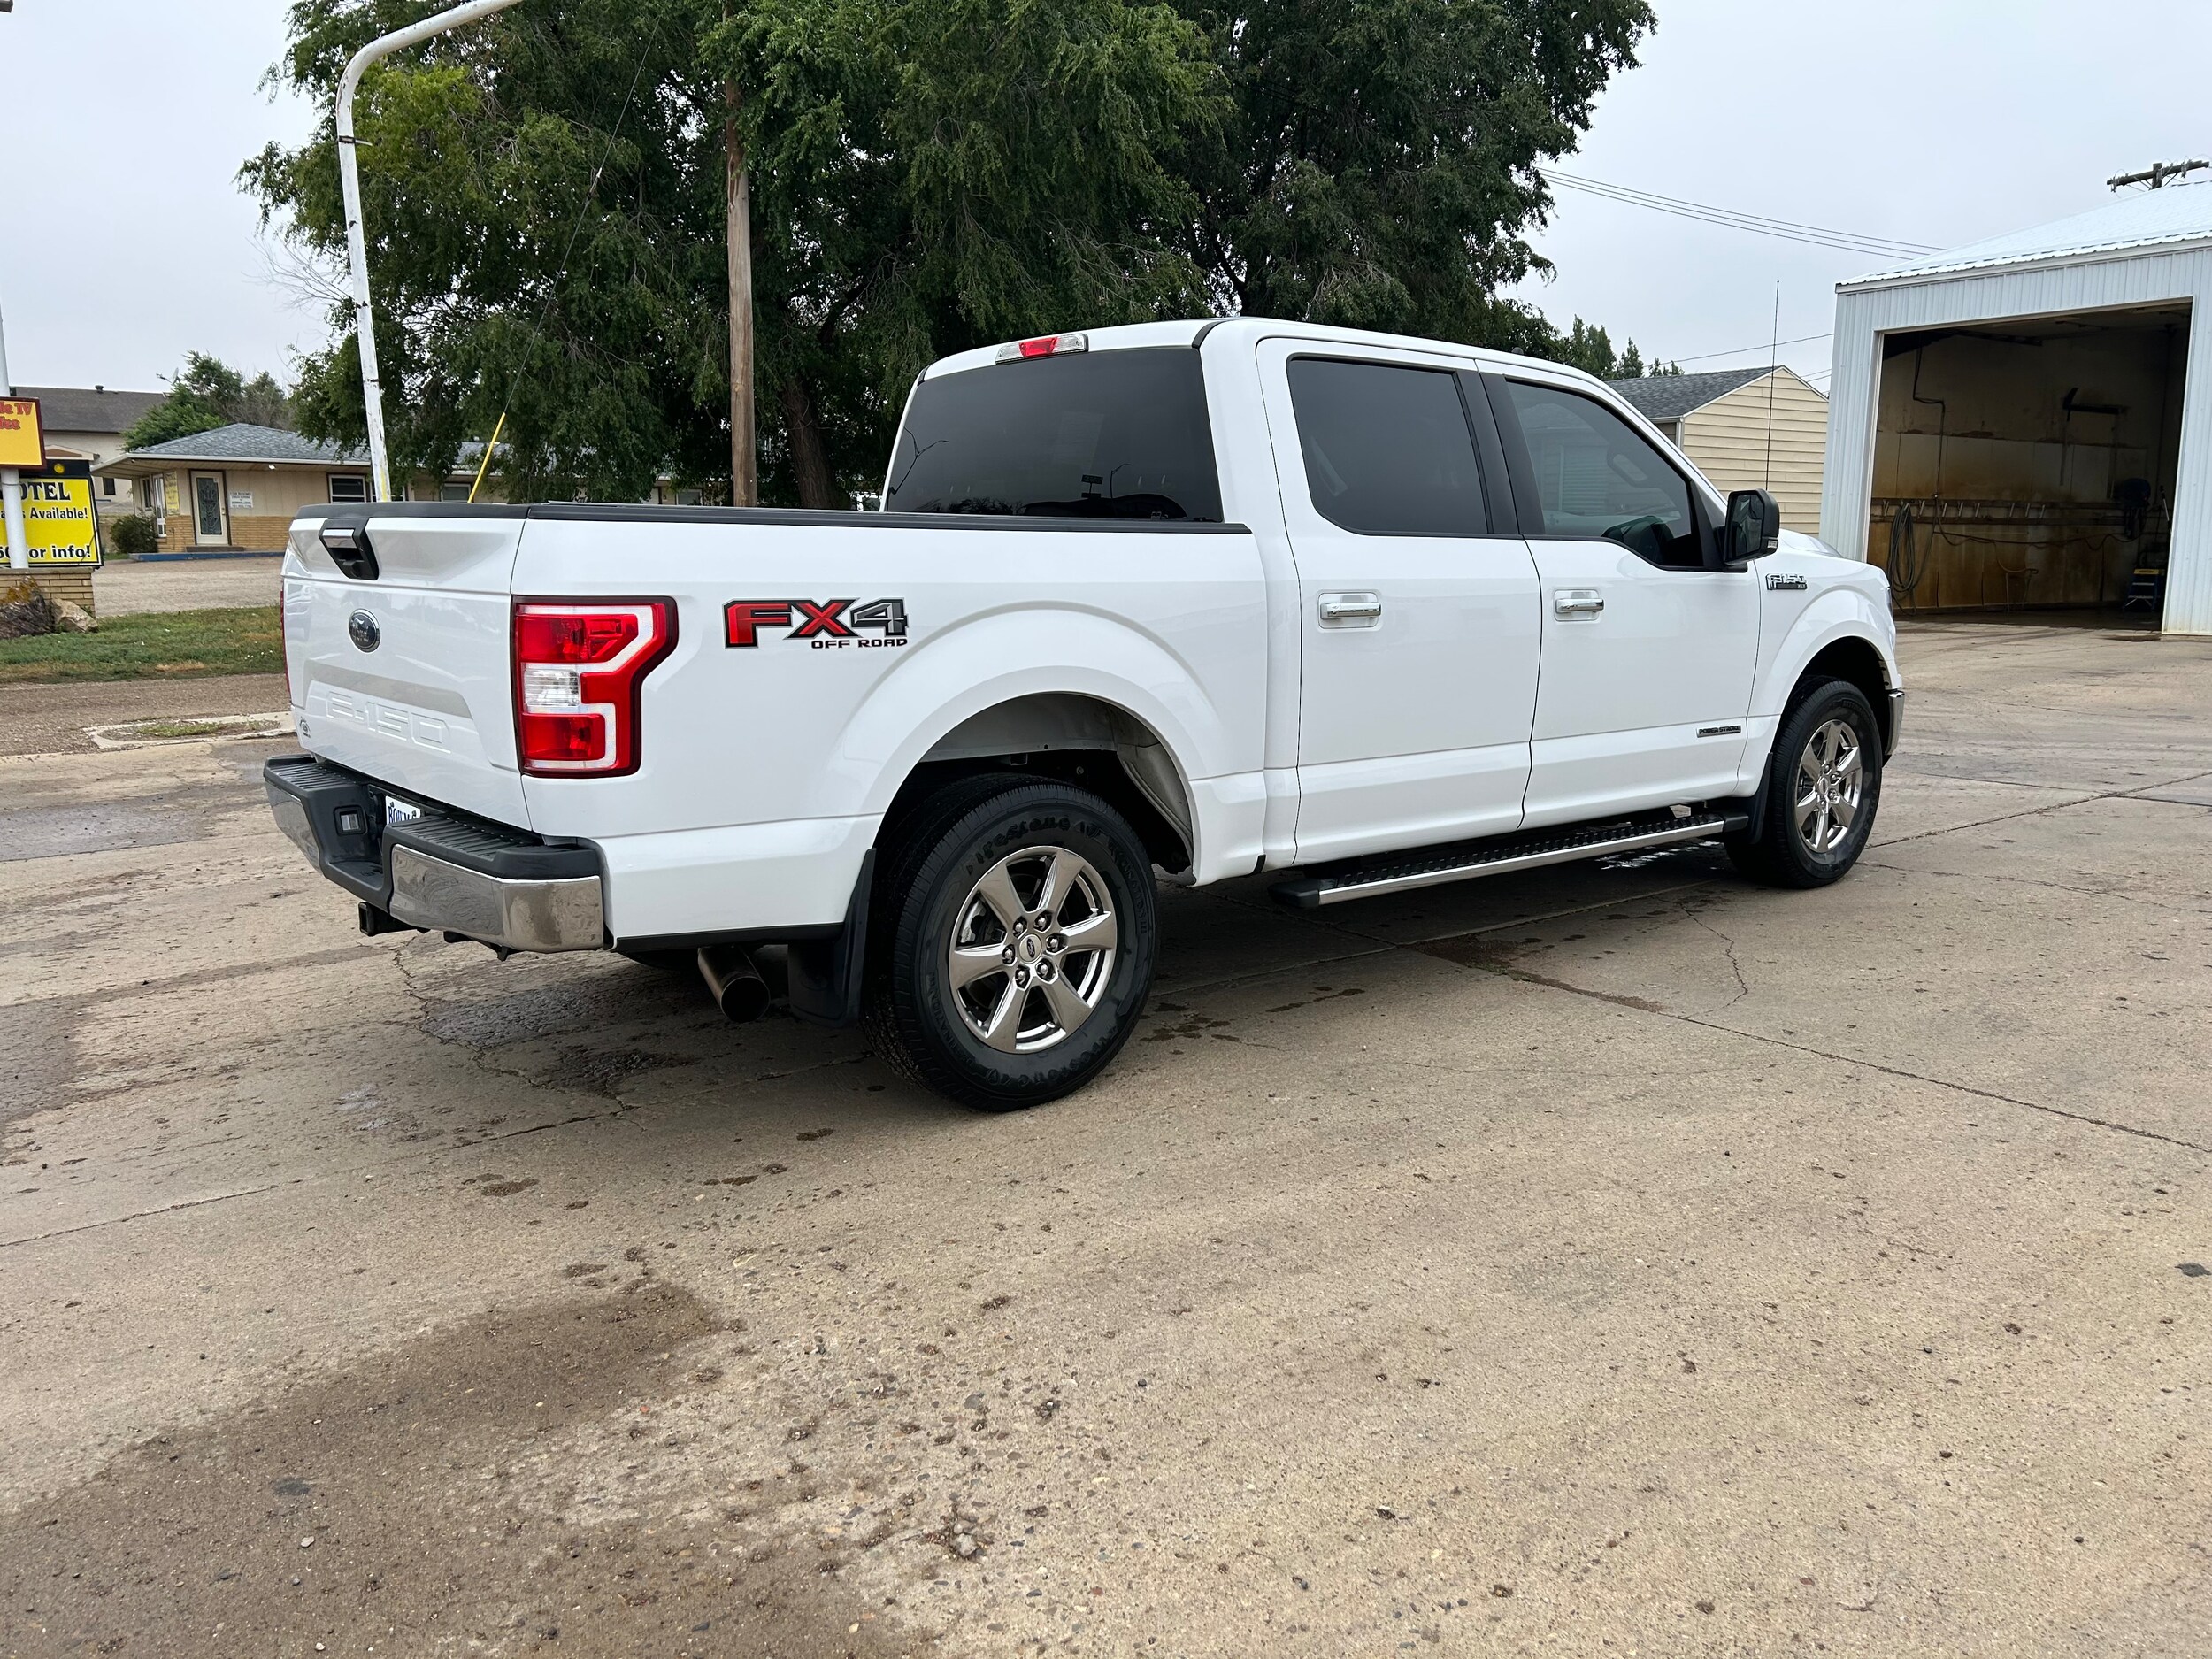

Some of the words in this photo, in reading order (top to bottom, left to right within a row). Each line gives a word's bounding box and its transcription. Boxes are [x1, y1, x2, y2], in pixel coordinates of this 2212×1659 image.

[14, 403, 33, 415] TV
[30, 507, 88, 519] Available!
[26, 545, 46, 558] or
[51, 545, 90, 558] info!
[722, 597, 909, 649] FX4
[811, 640, 850, 649] OFF
[857, 638, 908, 649] ROAD
